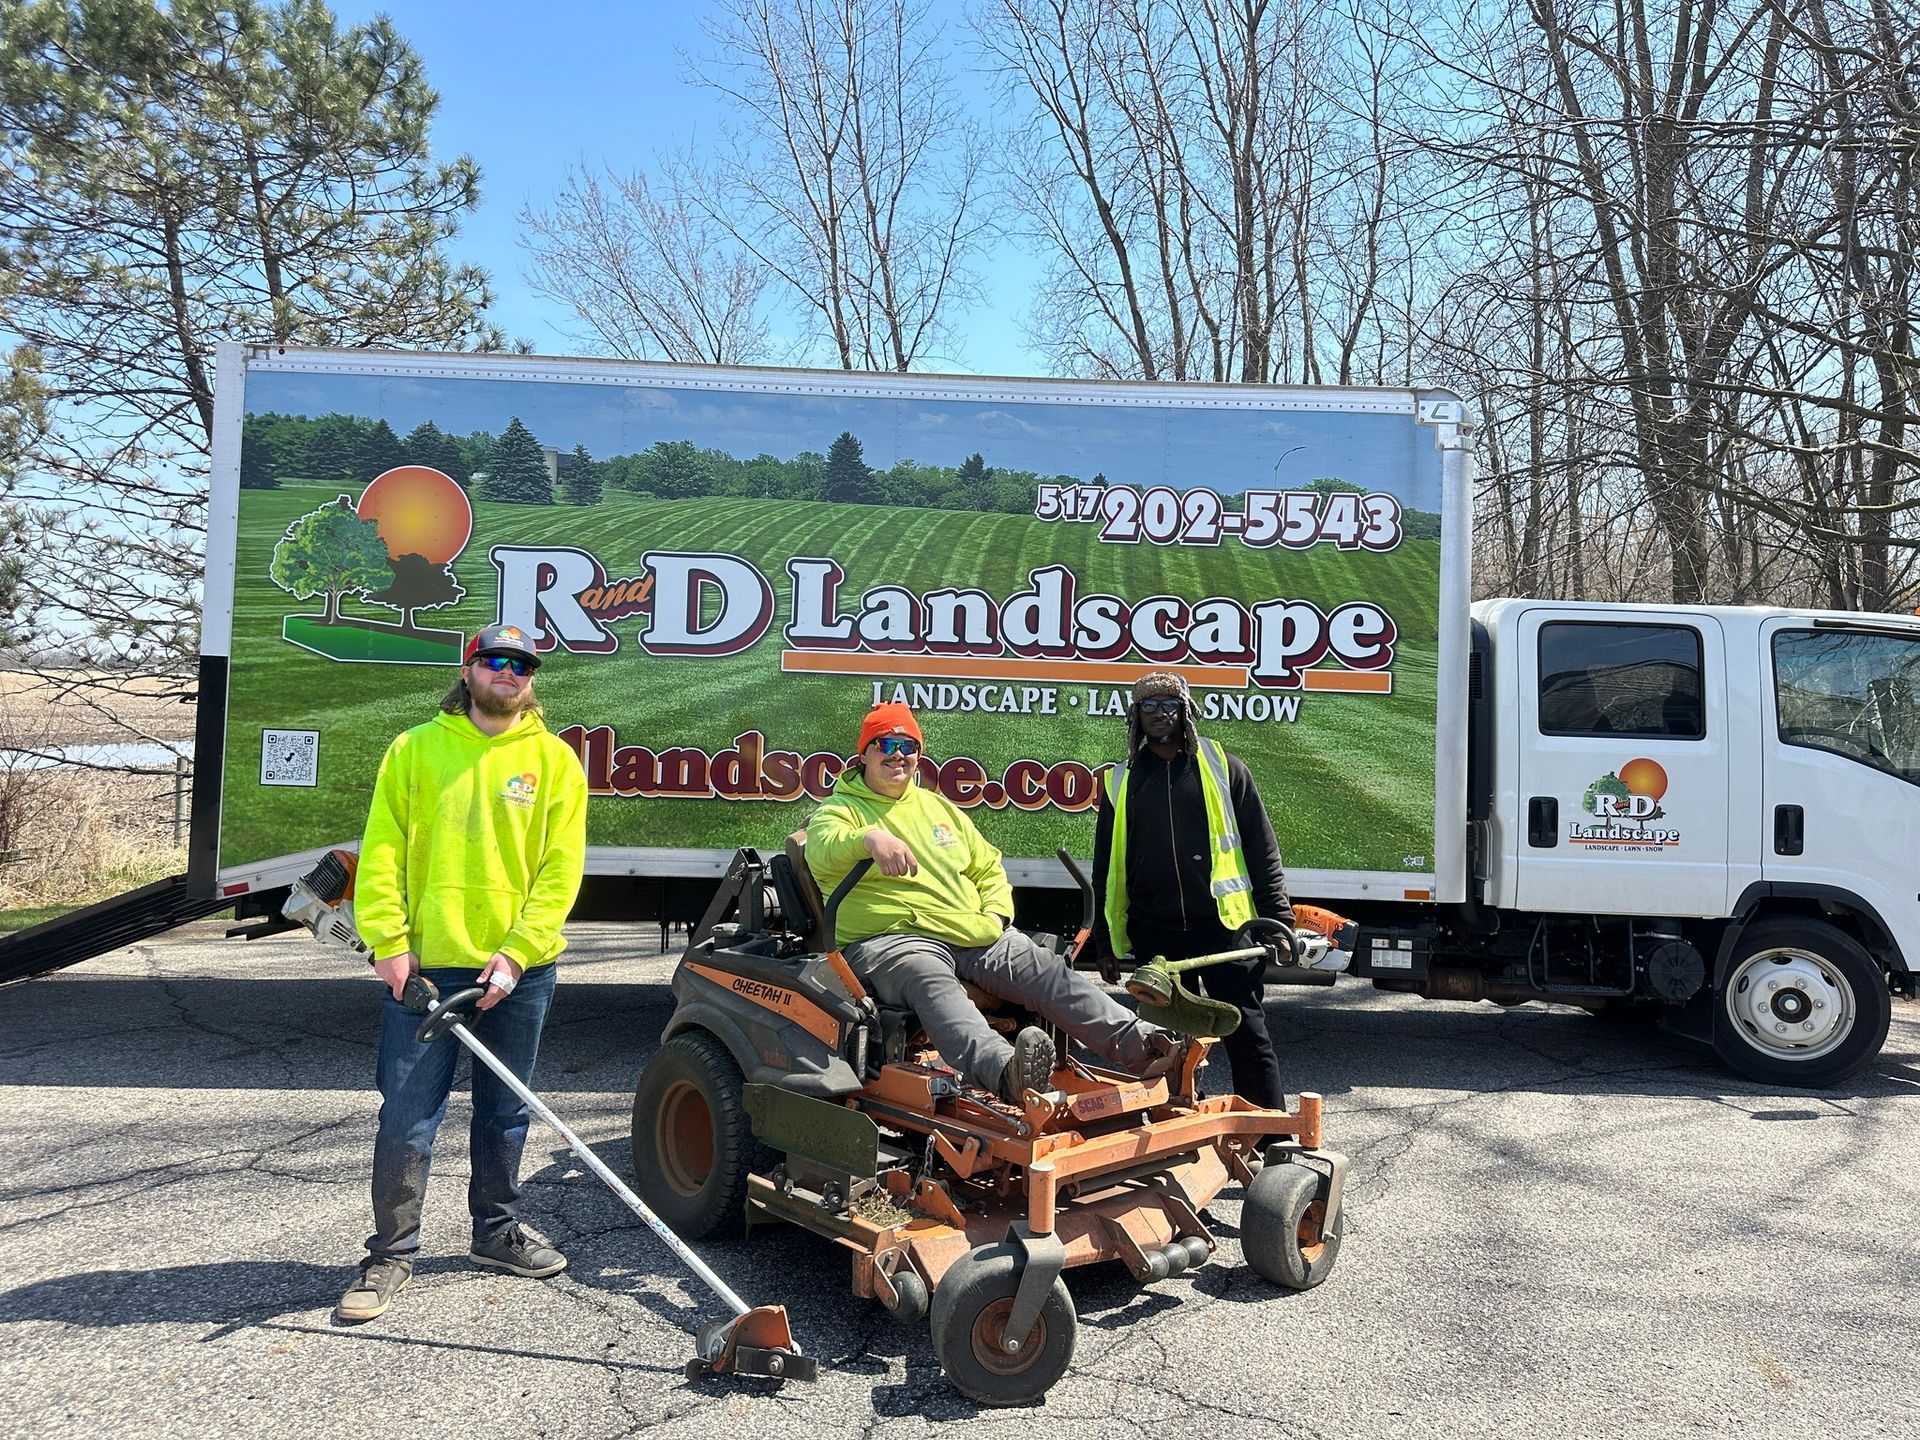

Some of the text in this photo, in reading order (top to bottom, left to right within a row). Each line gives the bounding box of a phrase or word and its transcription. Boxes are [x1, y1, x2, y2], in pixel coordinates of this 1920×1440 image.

[1036, 486, 1401, 551] 517 202-5543
[491, 547, 1394, 687] R and D Landscape
[871, 682, 1057, 714] LANDSCAPE
[1203, 692, 1301, 722] SNOW
[1594, 794, 1620, 817] R
[1628, 794, 1657, 819] D
[1569, 821, 1679, 845] Landscape
[1584, 844, 1619, 852] LANDSCAPE
[1303, 919, 1323, 929] STIHL
[732, 978, 783, 1004] CHEETAH
[1077, 1095, 1107, 1114] SCAG
